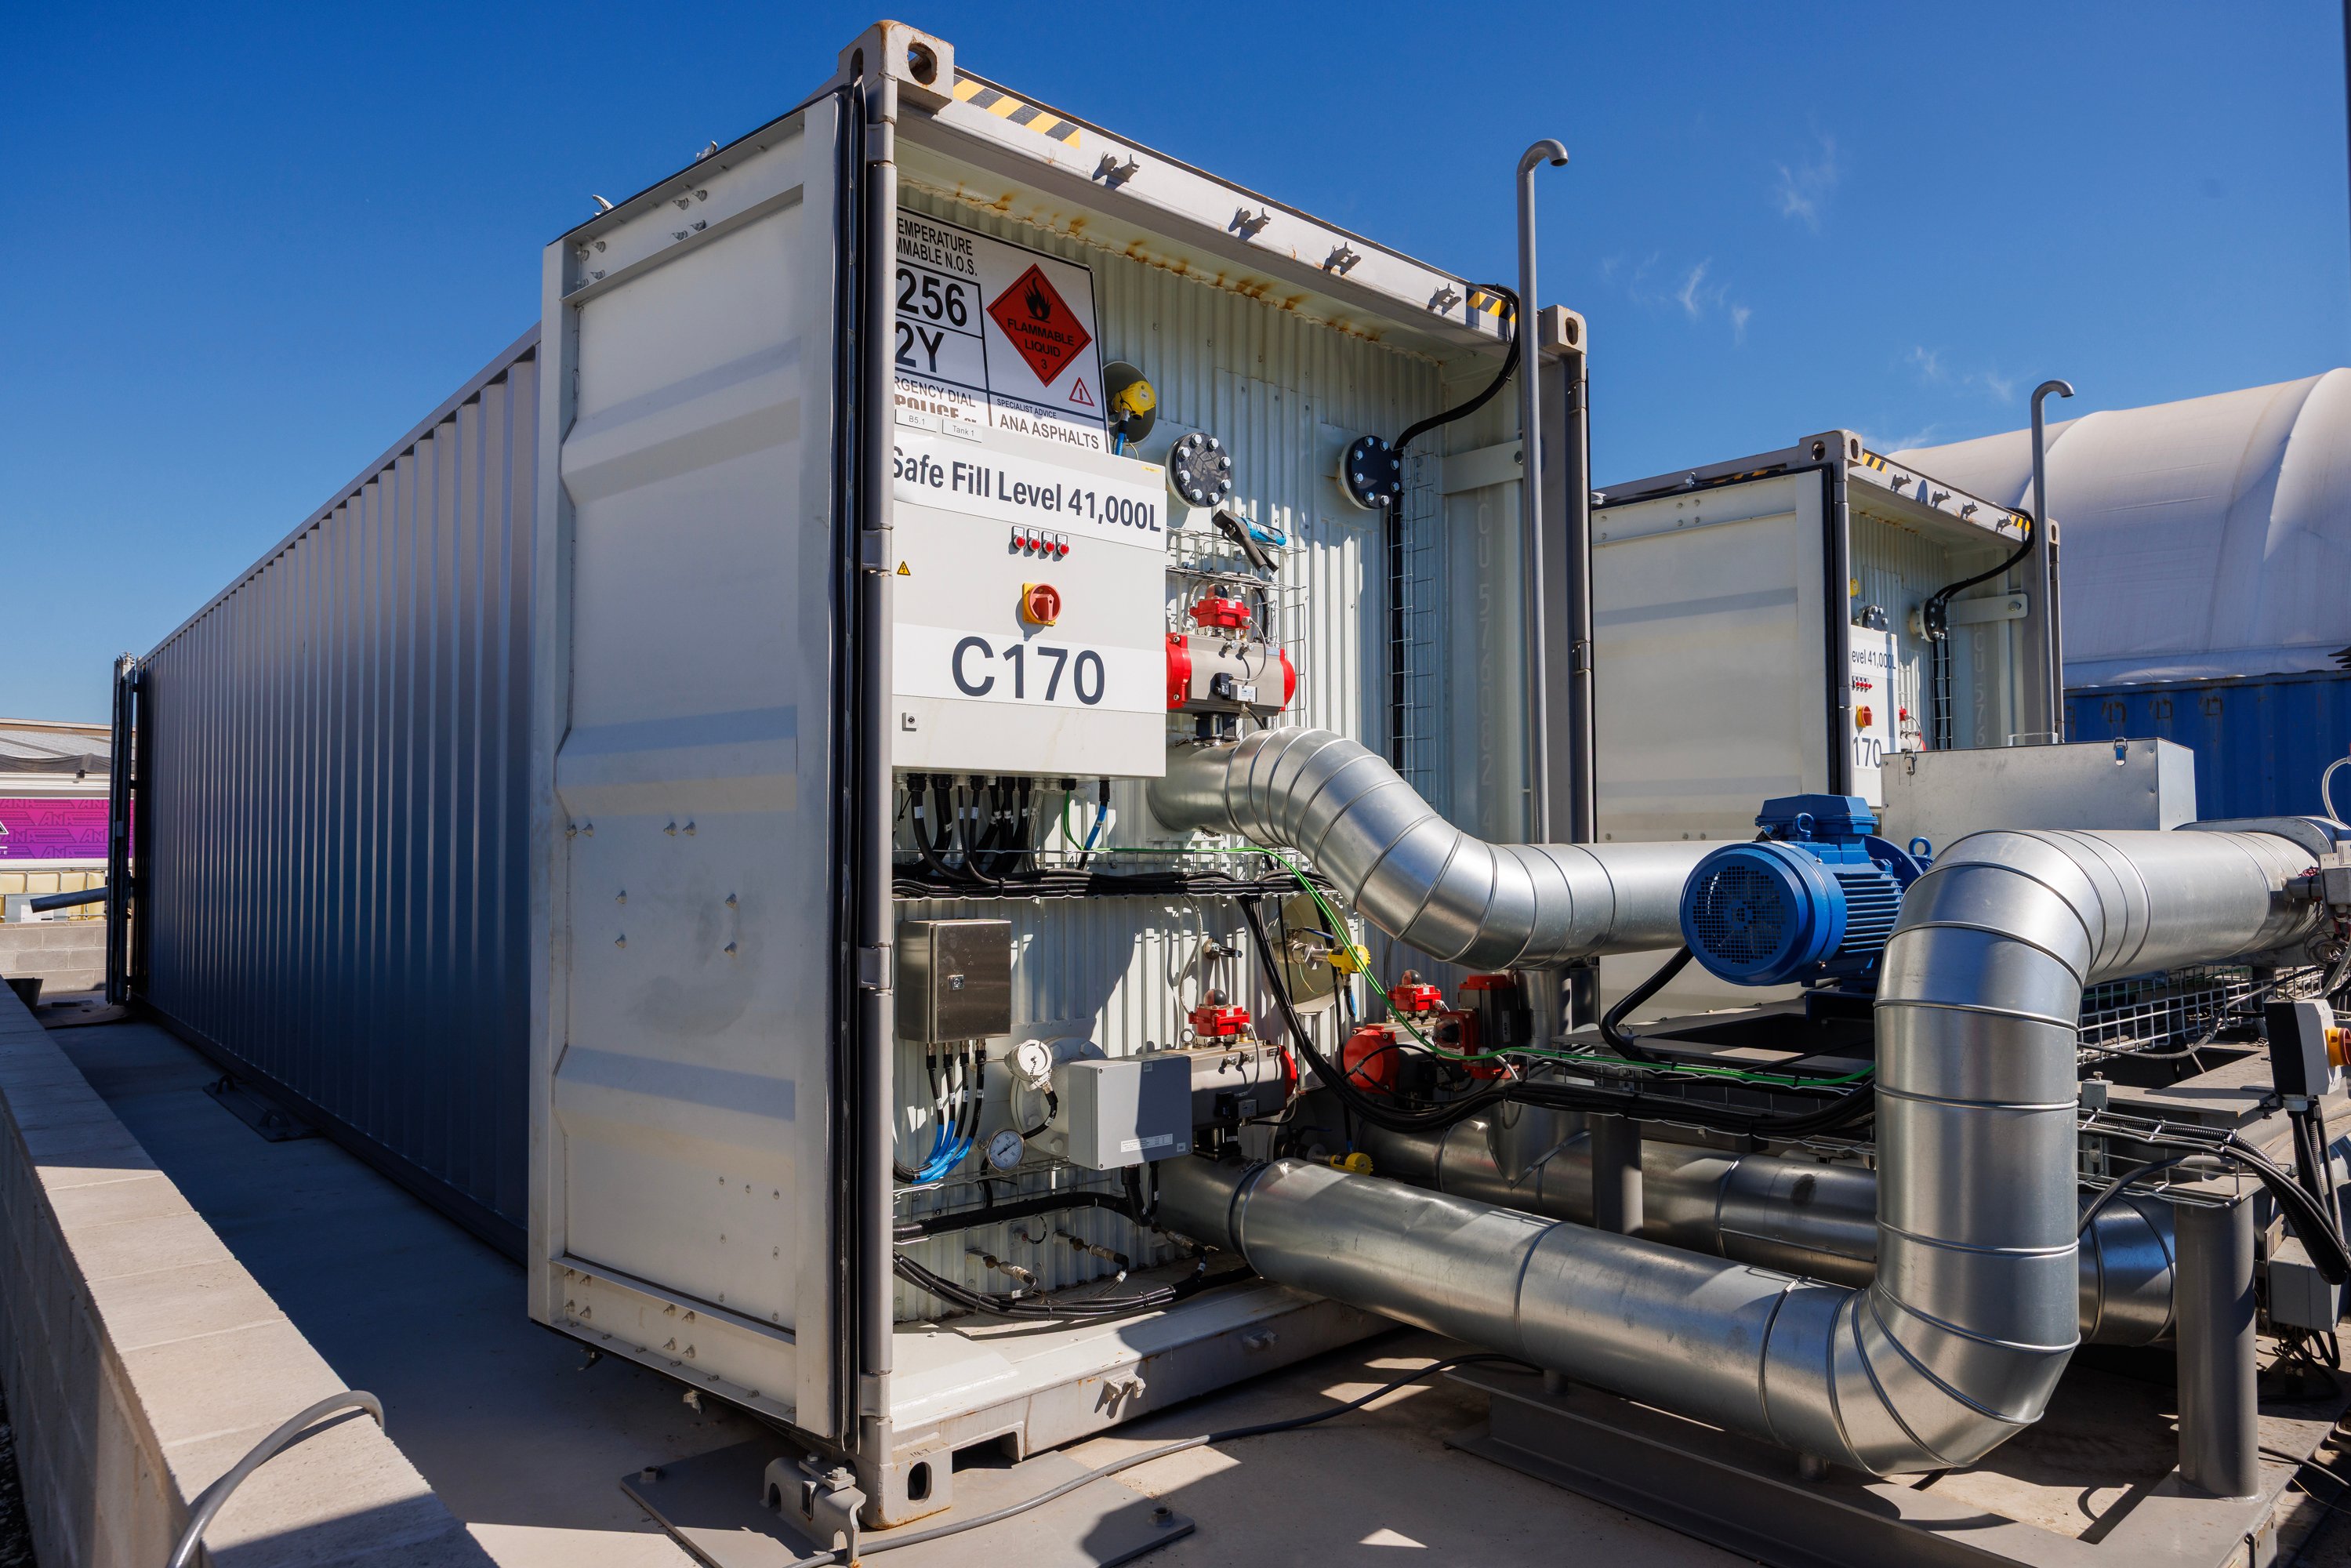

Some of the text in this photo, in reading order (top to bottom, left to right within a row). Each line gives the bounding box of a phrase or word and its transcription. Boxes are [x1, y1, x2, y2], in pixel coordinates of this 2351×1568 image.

[945, 252, 978, 277] N.O.S.
[896, 268, 967, 327] 256
[1007, 318, 1074, 347] FLAMMABLE
[895, 321, 945, 372] 2Y
[1025, 339, 1061, 358] LIQUID
[1040, 358, 1047, 370] 3
[948, 389, 976, 408] DIAL
[996, 398, 1057, 419] SPECIALIST ADVICE
[909, 415, 925, 425] B5.1
[952, 425, 969, 436] Tank
[1000, 414, 1099, 450] ANA ASPHALTS
[952, 460, 990, 497] Fill
[998, 470, 1061, 512] Level
[1068, 488, 1162, 532] 41,000L
[952, 636, 1105, 706] C170
[1852, 648, 1896, 670] evel 41,000L
[1853, 736, 1882, 768] 170
